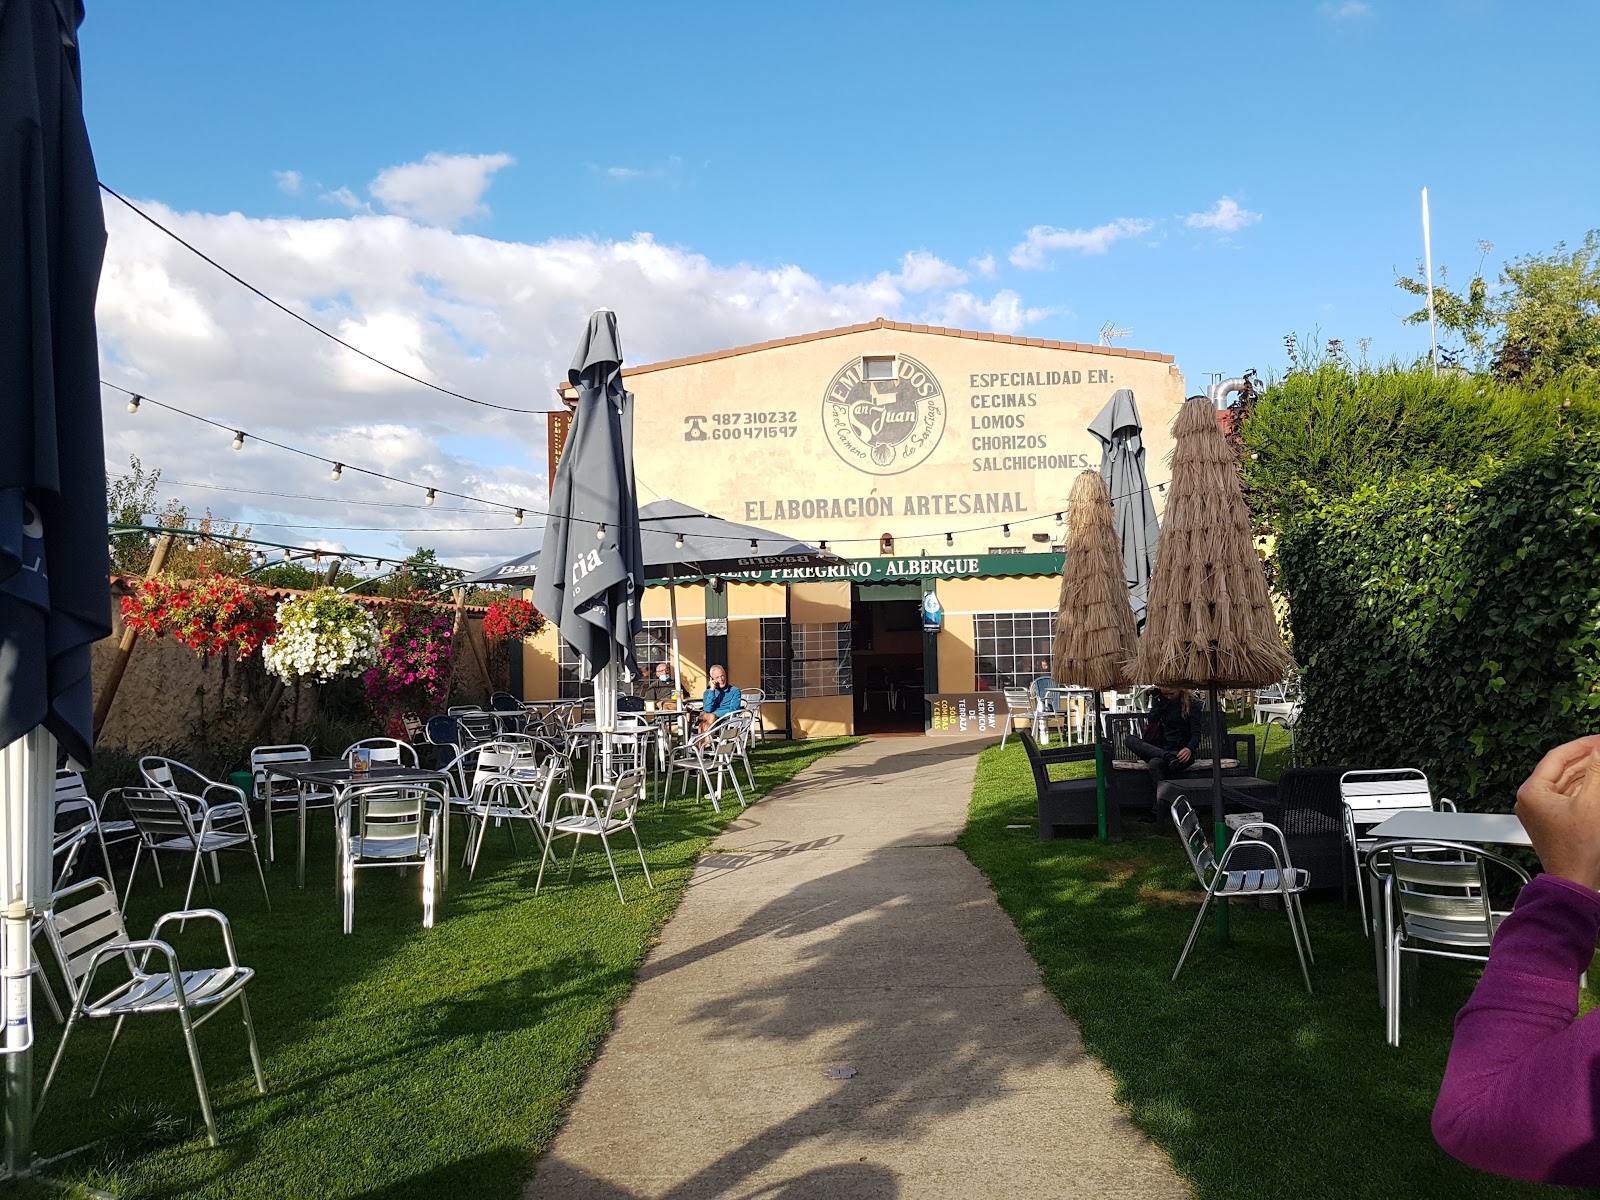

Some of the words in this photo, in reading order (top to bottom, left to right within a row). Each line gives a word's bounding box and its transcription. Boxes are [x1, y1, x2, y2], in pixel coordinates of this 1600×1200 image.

[970, 371, 1082, 388] ESPECIALIDAD
[1088, 369, 1114, 384] EN:
[971, 393, 1037, 409] CECINAS
[837, 428, 867, 459] Camino
[911, 400, 941, 448] Santiago
[869, 406, 916, 436] Juan
[971, 414, 1025, 430] LOMOS
[972, 434, 1047, 451] CHORIZOS
[745, 488, 893, 521] ELABORACIÓN
[903, 492, 1028, 516] ARTESANAL
[769, 562, 872, 578] PEREGRINO
[885, 559, 979, 576] ALBERGUE
[941, 700, 949, 731] COMIDAS
[959, 698, 967, 732] TERRAZA
[968, 710, 976, 720] DE
[978, 698, 986, 732] SERVICIO
[987, 701, 994, 713] NO
[987, 713, 996, 729] HAY
